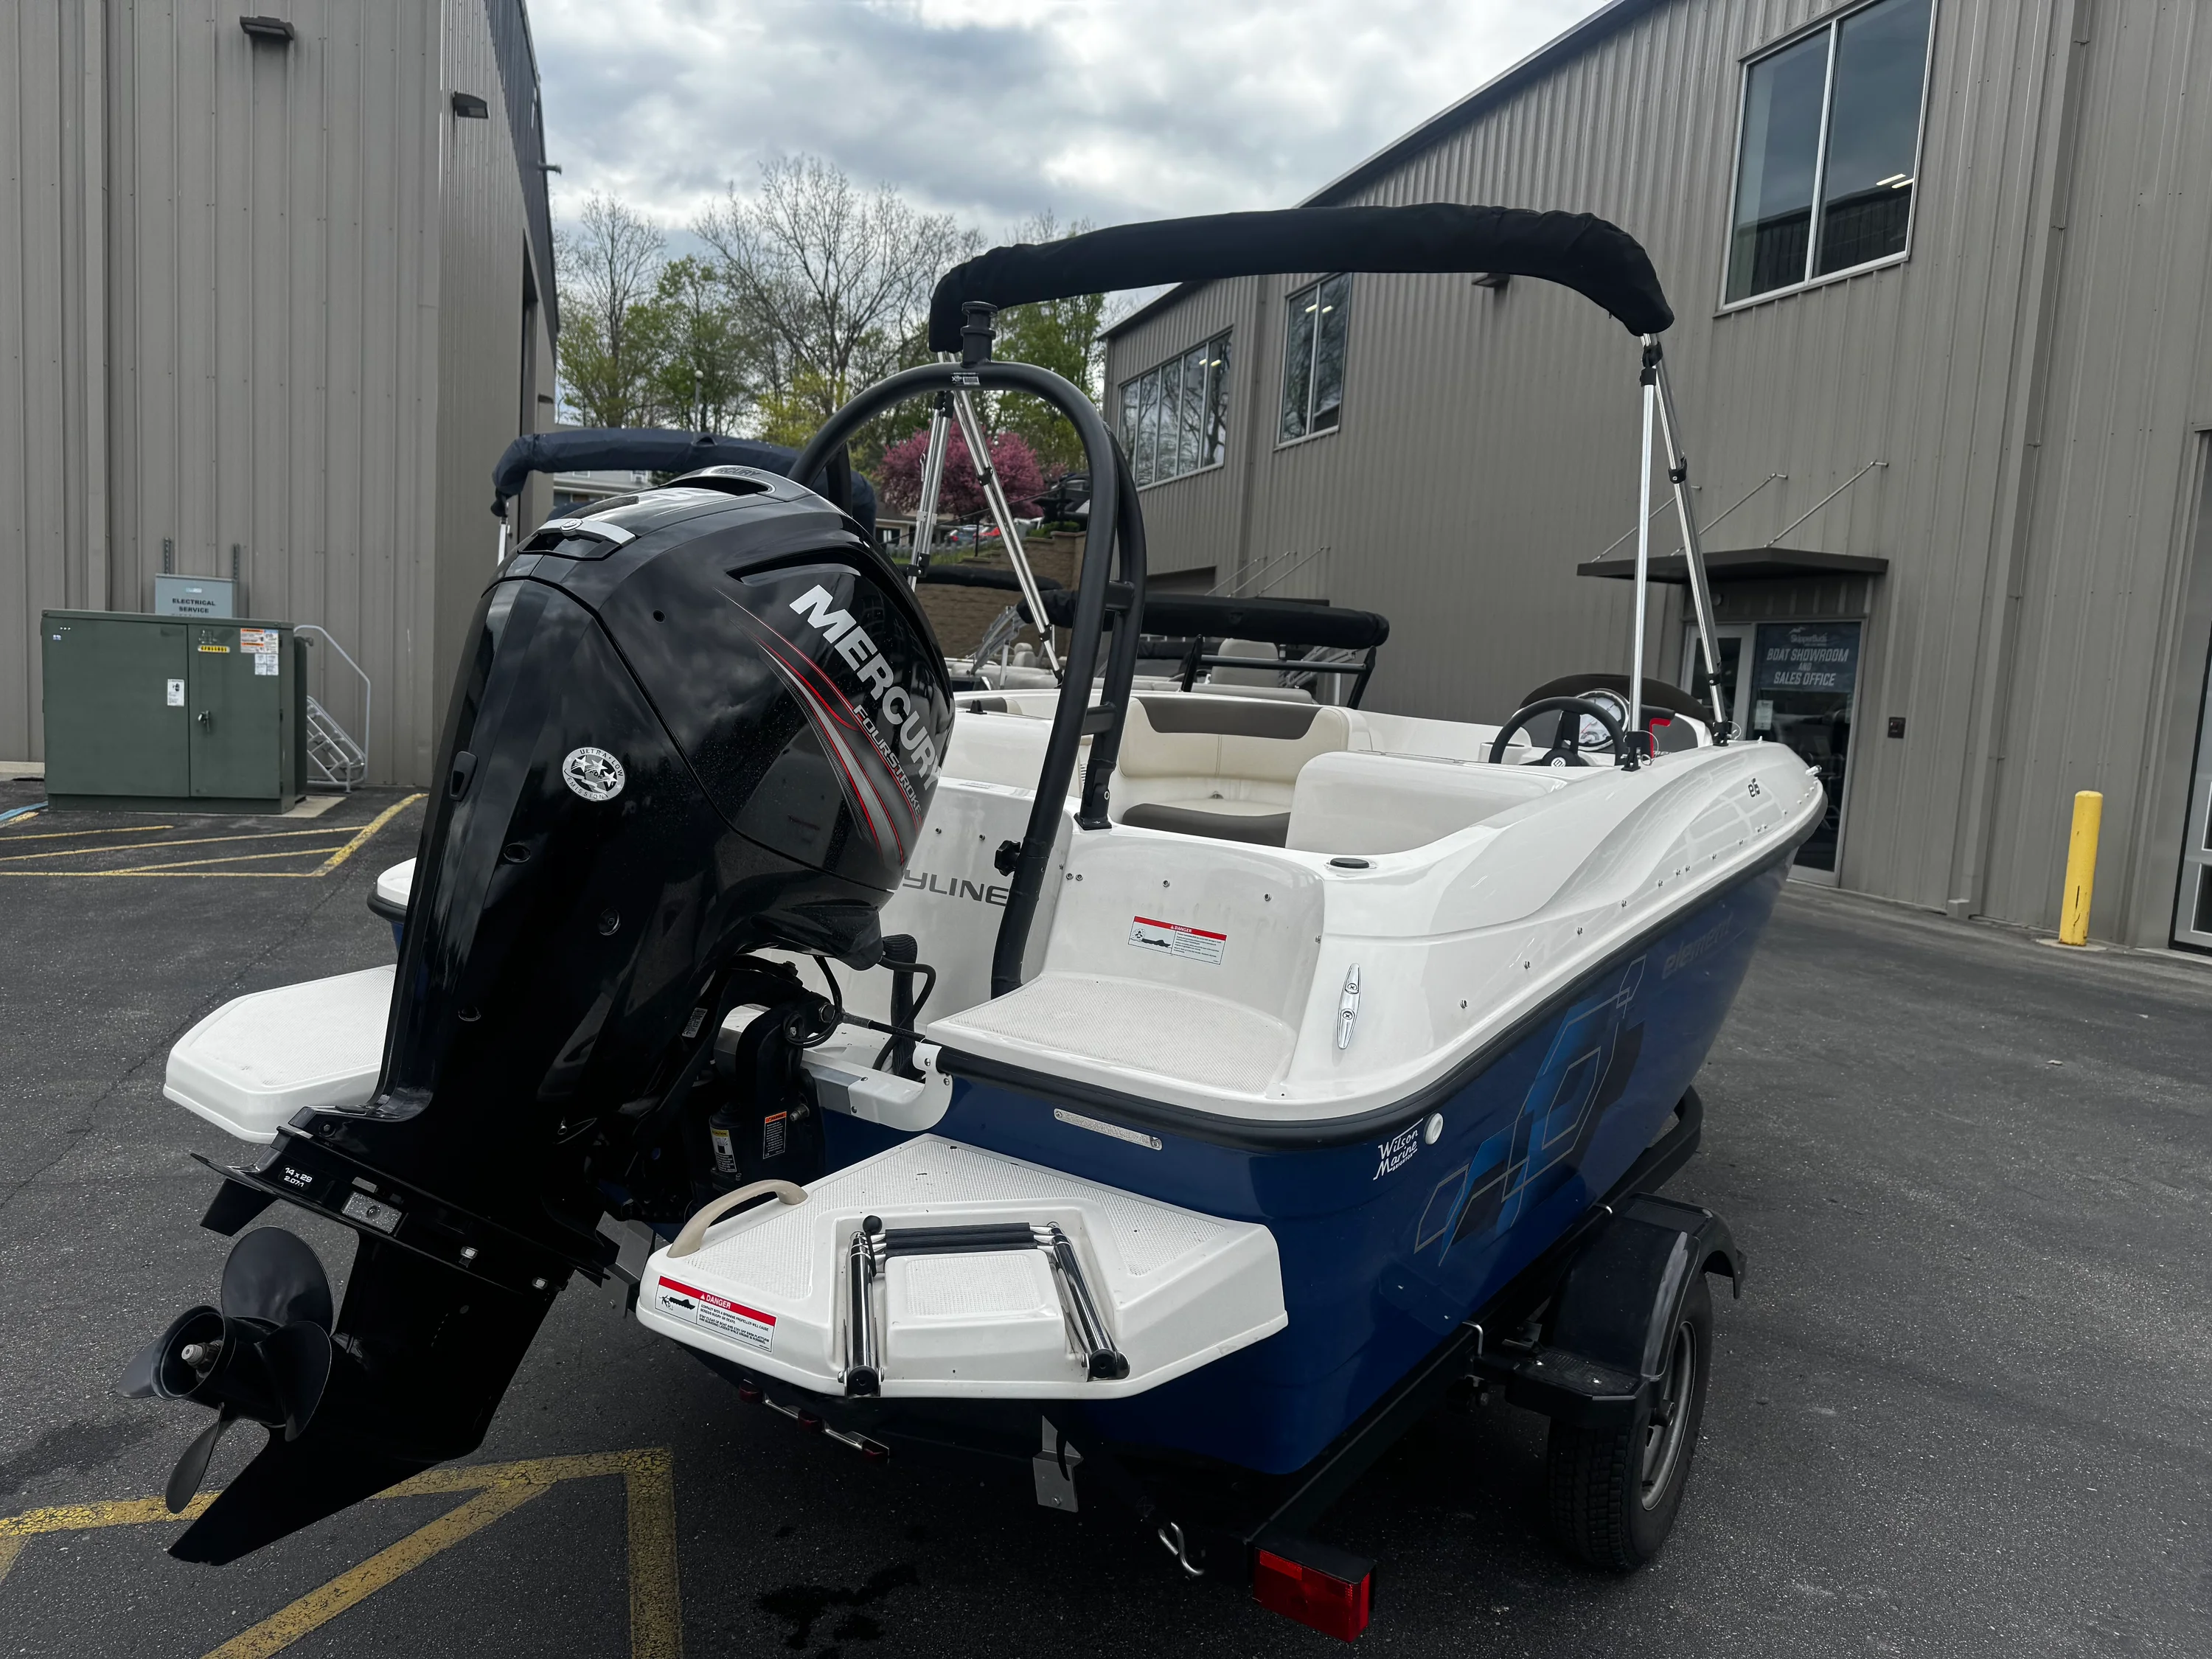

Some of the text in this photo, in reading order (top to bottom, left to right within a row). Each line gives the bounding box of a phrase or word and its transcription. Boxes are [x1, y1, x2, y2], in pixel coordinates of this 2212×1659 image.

[716, 467, 762, 476] RCURY
[172, 598, 216, 606] ELECTRICAL
[1767, 648, 1849, 662] BOAT SHOWROOM
[1798, 662, 1812, 671] AND
[1773, 672, 1836, 686] SALES OFFICE
[789, 585, 942, 791] MERCURY
[580, 748, 607, 758] ULTRA
[611, 759, 624, 776] LOW
[853, 704, 922, 816] FOURSTROKE
[566, 776, 604, 800] EMISSION
[902, 869, 1009, 907] YLINE
[1174, 925, 1192, 933] DANGER
[1378, 1127, 1419, 1160] Wilson
[1373, 1141, 1418, 1180] Marine
[285, 1167, 295, 1176] 14
[300, 1174, 313, 1183] 29
[706, 1294, 731, 1309] DANGER
